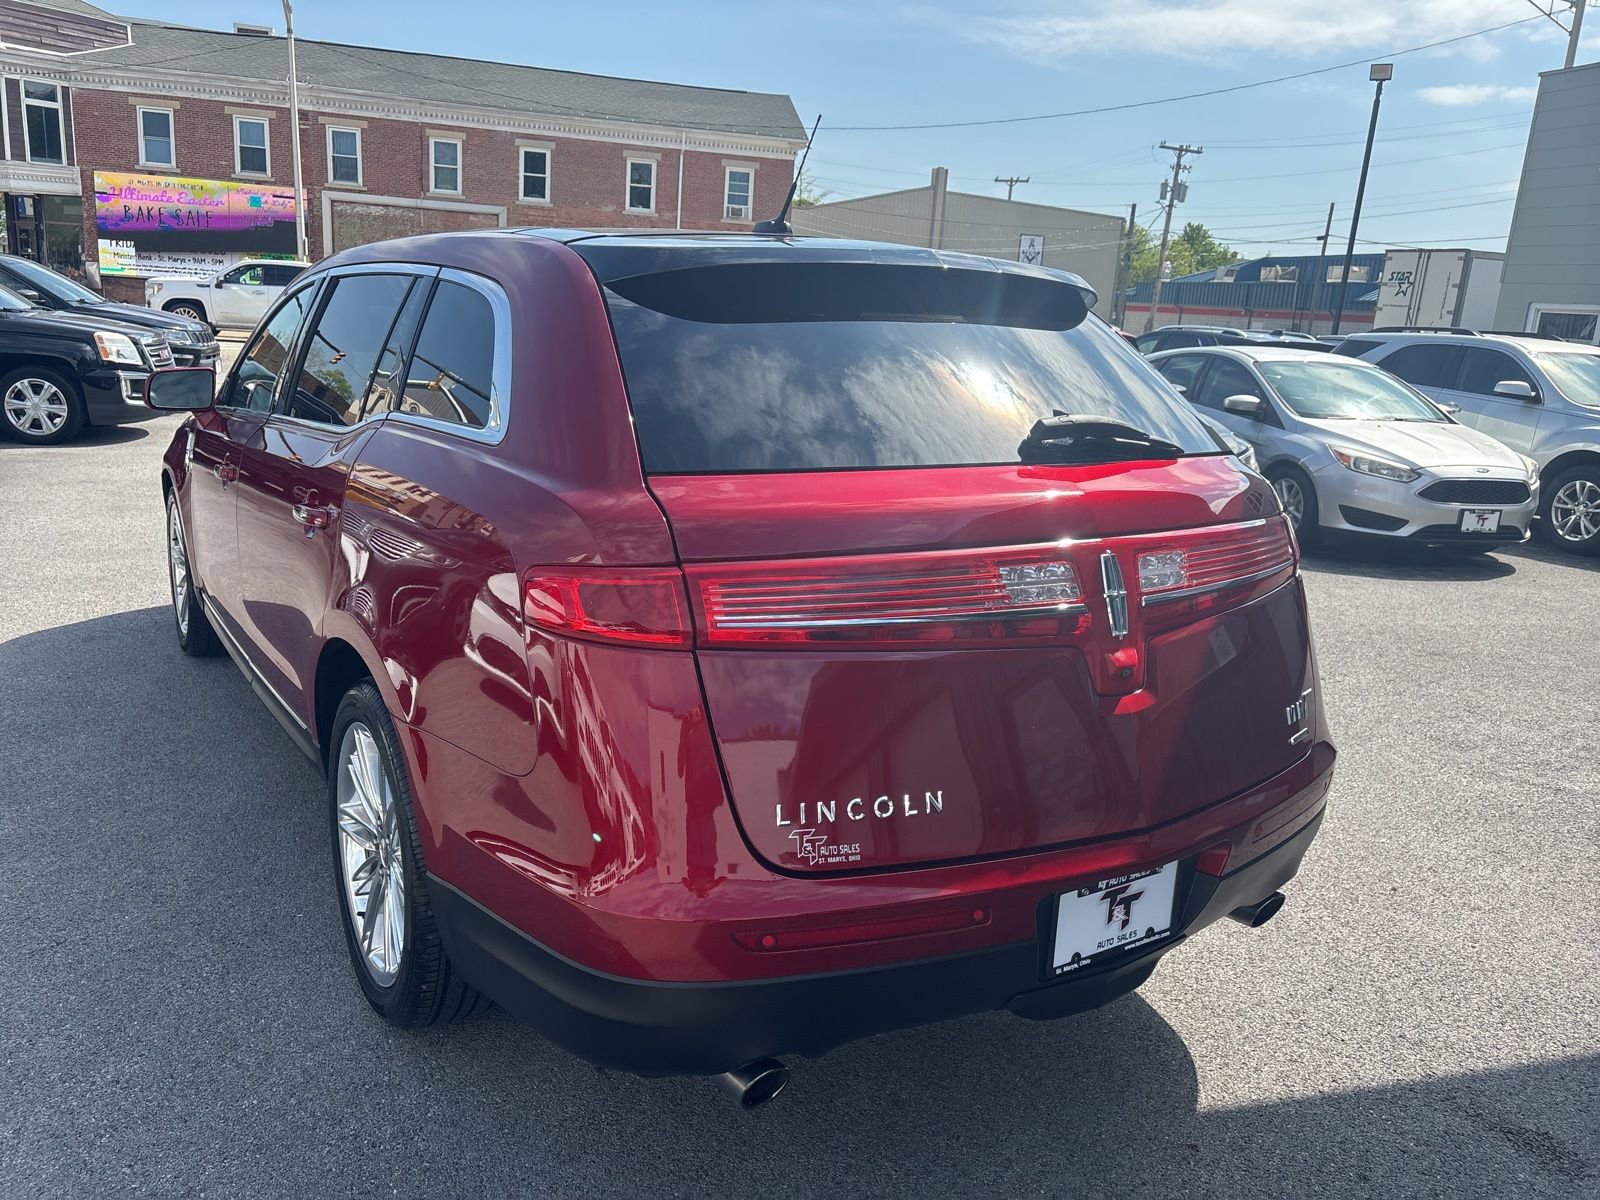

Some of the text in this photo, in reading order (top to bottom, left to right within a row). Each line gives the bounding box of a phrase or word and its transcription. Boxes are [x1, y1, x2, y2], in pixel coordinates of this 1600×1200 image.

[108, 187, 174, 204] Ultimate
[176, 191, 225, 207] Easter
[123, 205, 168, 227] BAKE
[1388, 271, 1413, 282] STAR
[775, 790, 943, 826] LINCOLN
[820, 843, 860, 856] AUTO SALES
[848, 854, 861, 862] OHIO
[1096, 937, 1114, 950] AUTO
[1116, 929, 1138, 943] SALES
